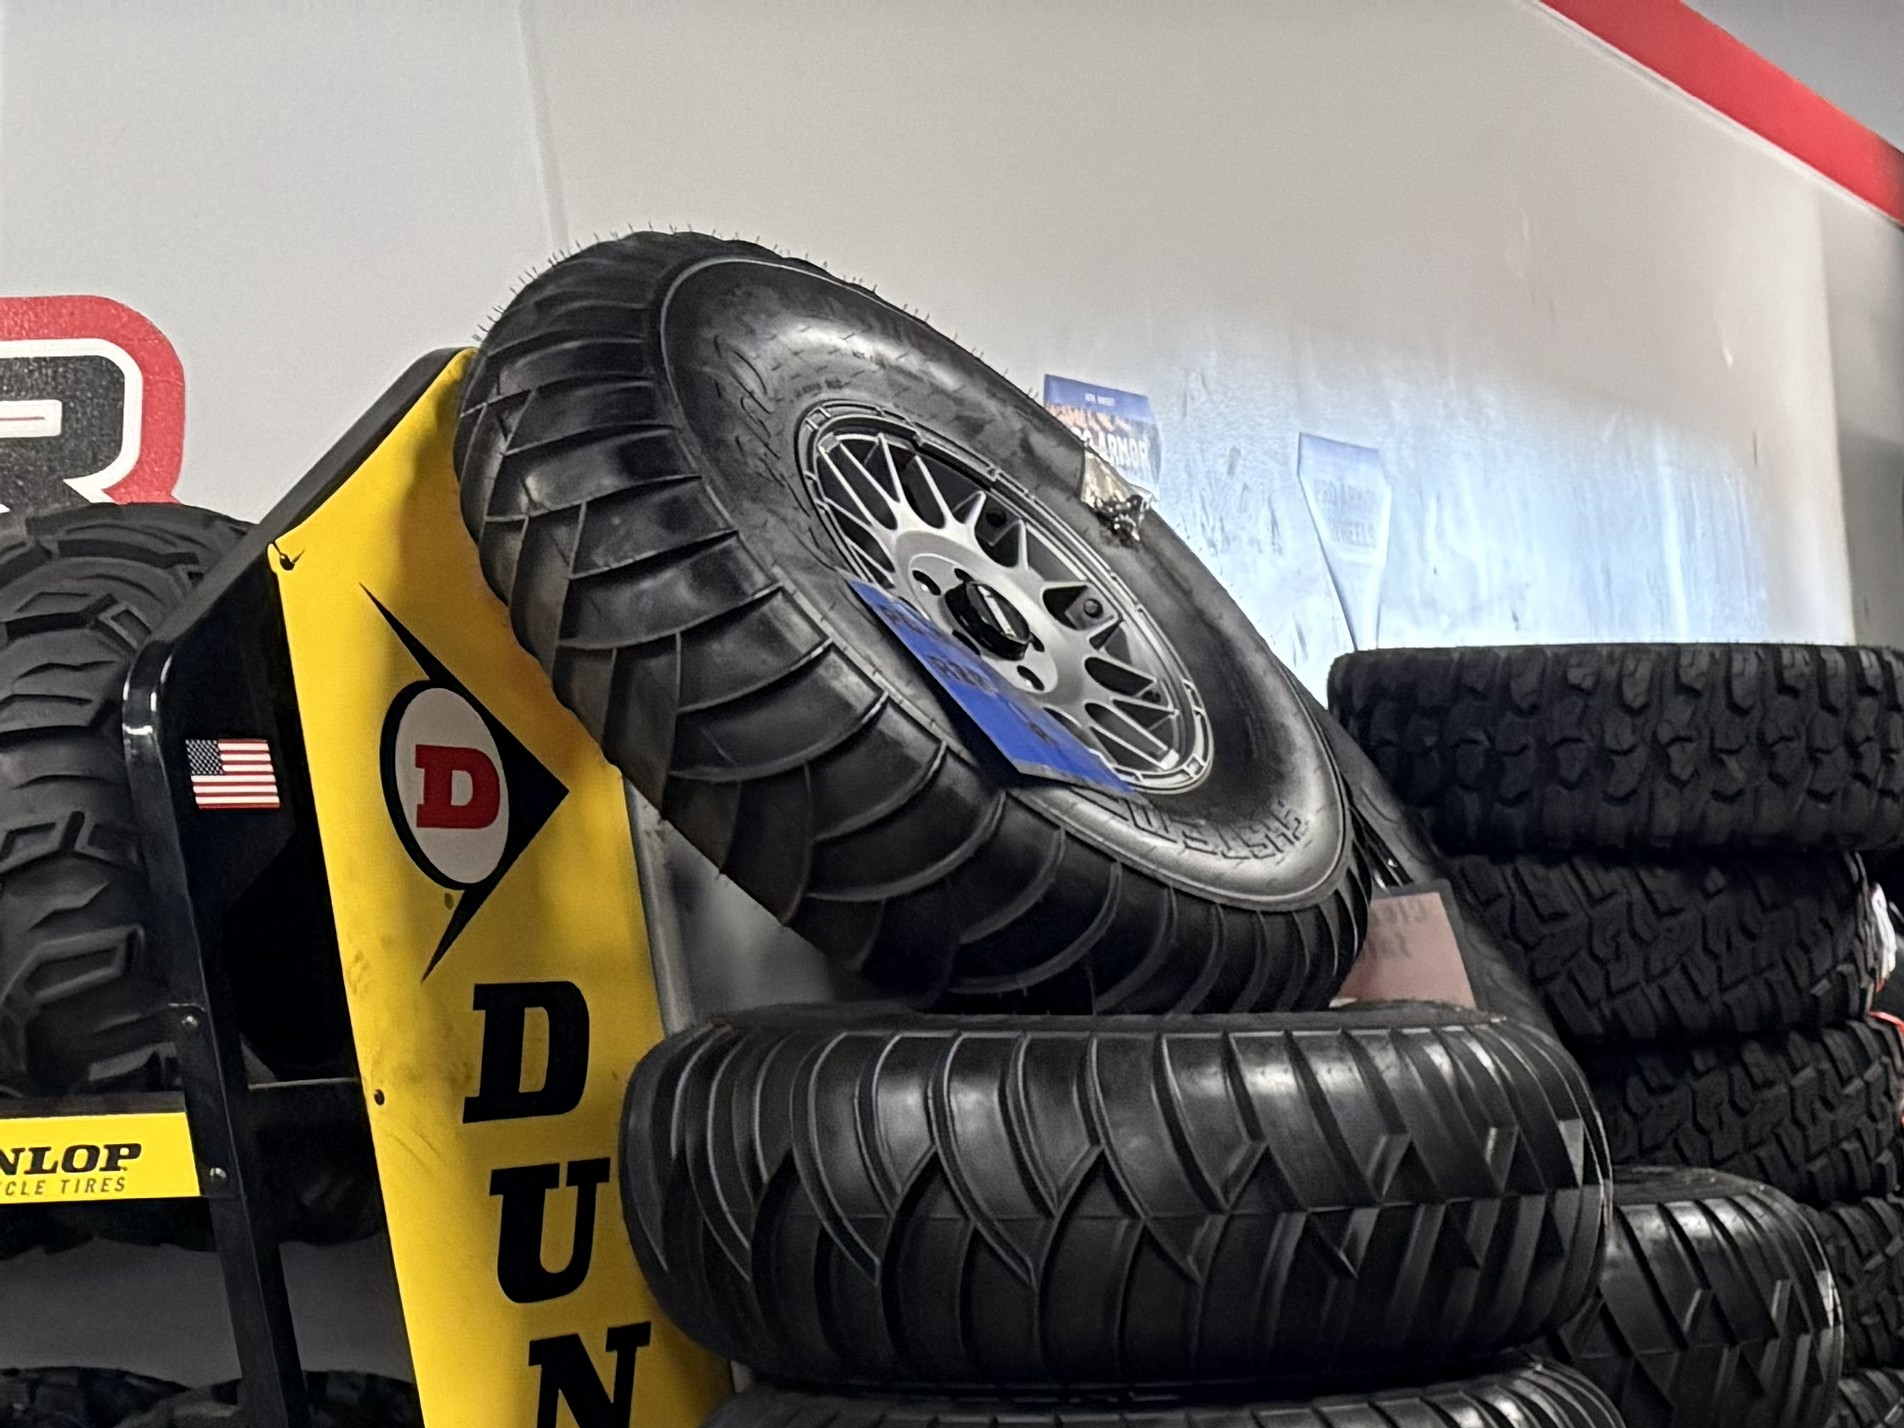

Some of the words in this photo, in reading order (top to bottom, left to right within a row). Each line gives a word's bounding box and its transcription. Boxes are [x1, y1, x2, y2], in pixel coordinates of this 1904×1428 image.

[415, 746, 501, 829] D
[0, 1179, 46, 1197] CLE
[61, 1177, 126, 1194] TIRES
